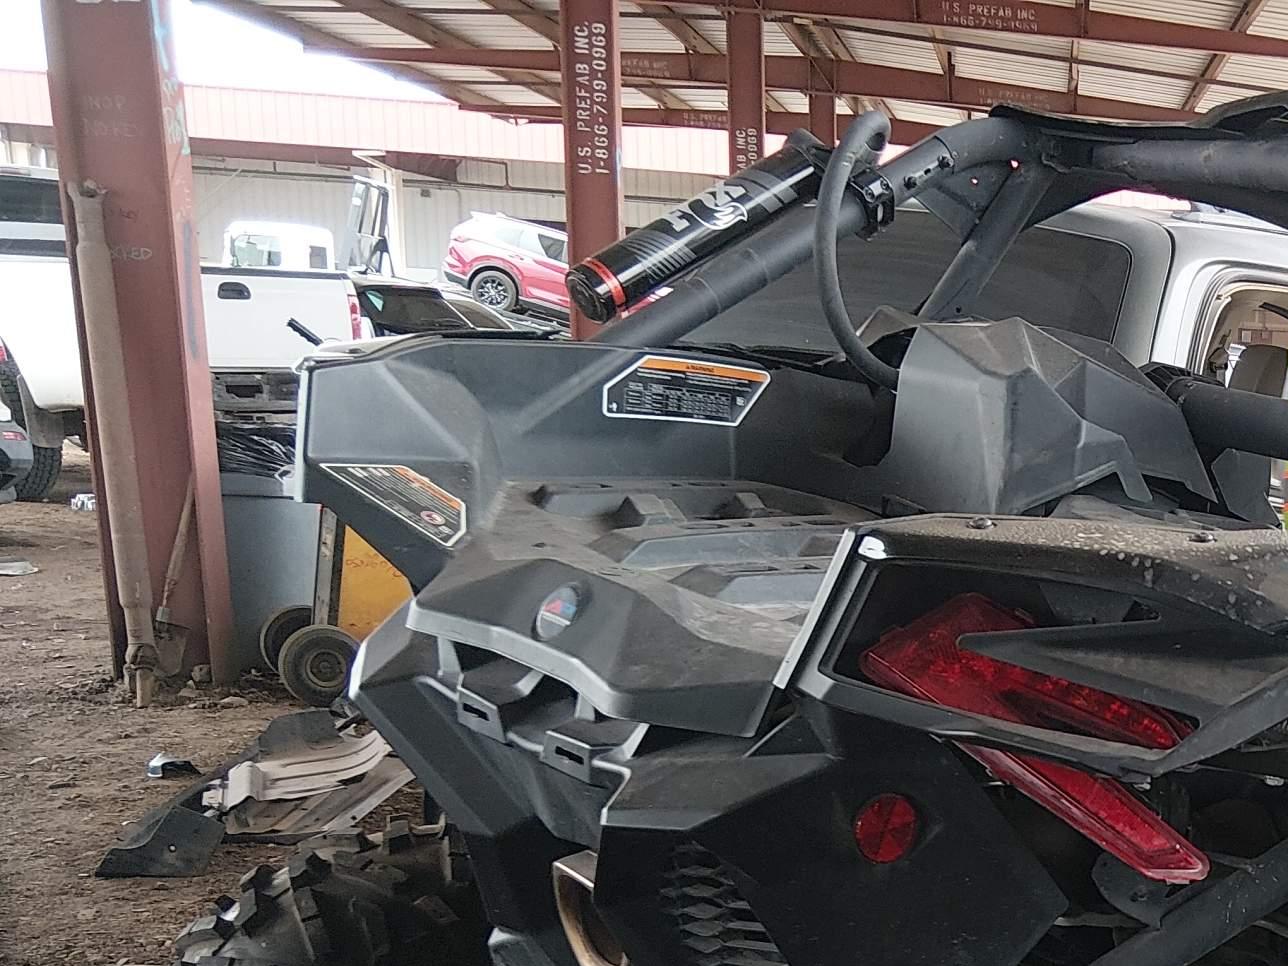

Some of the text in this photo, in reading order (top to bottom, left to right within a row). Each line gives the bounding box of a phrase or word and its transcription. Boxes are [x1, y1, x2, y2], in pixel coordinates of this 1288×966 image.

[968, 4, 1012, 19] PREFAB
[575, 63, 591, 132] PREFAB
[591, 22, 609, 174] 1-866-799-0969
[577, 142, 592, 174] U.S.
[663, 181, 747, 231] FOX
